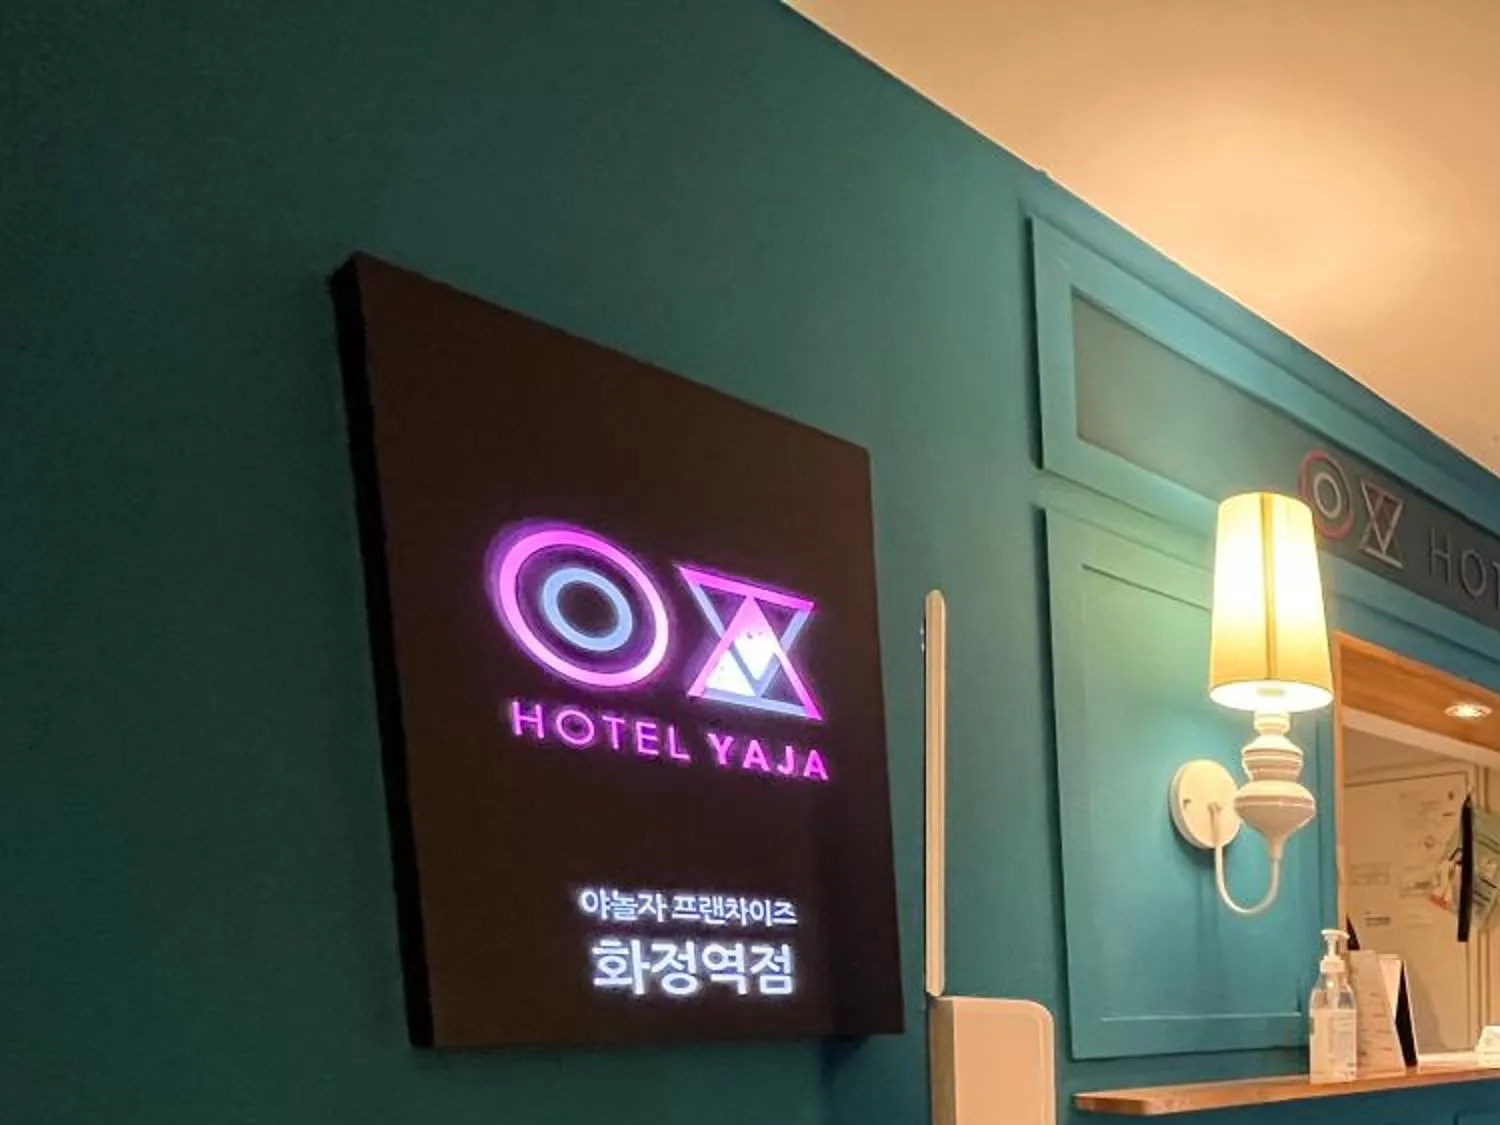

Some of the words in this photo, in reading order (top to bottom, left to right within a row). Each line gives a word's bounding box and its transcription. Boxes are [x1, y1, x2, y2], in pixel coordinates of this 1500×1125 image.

[510, 700, 691, 762] HOTEL
[707, 732, 830, 781] YAJA
[579, 888, 667, 923] 야놀자
[592, 938, 793, 995] 화정역점
